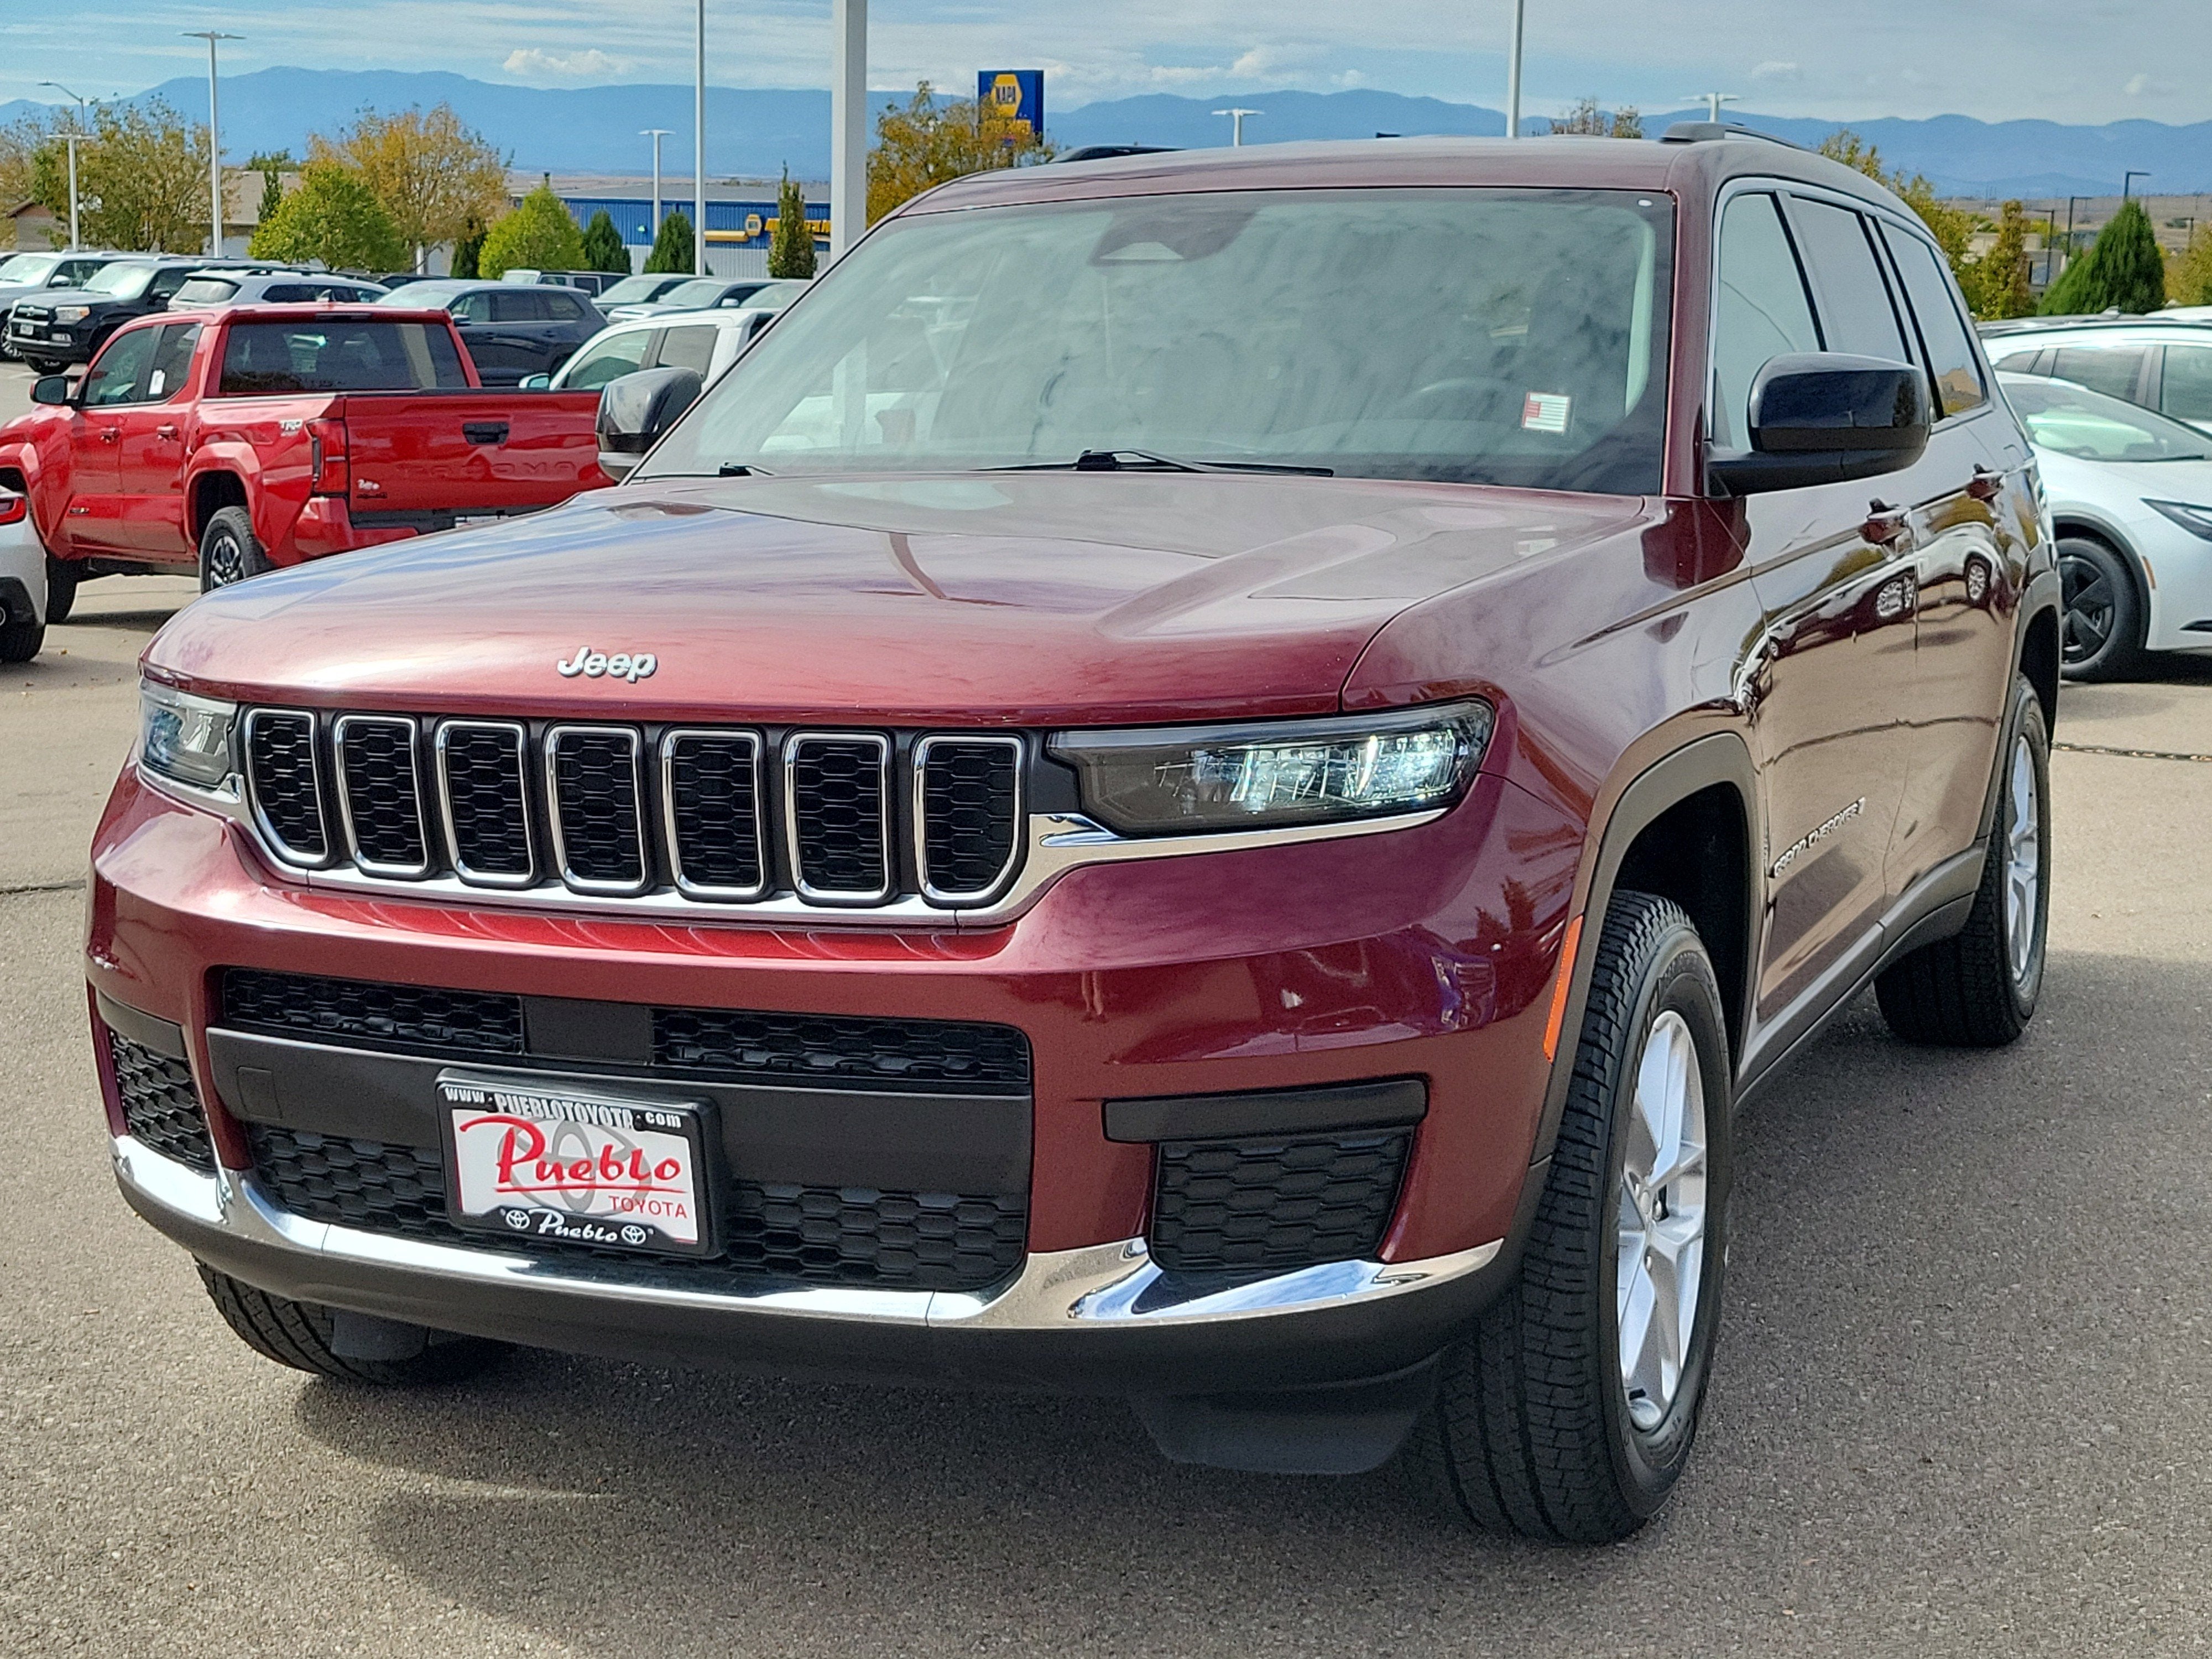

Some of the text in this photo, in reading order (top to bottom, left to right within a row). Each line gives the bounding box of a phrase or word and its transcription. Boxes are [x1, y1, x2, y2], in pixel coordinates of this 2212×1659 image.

[557, 645, 658, 684] Jeep
[460, 1115, 681, 1183] Pueblo
[528, 1208, 618, 1242] Pueblo
[608, 1196, 687, 1218] TOYOTA
